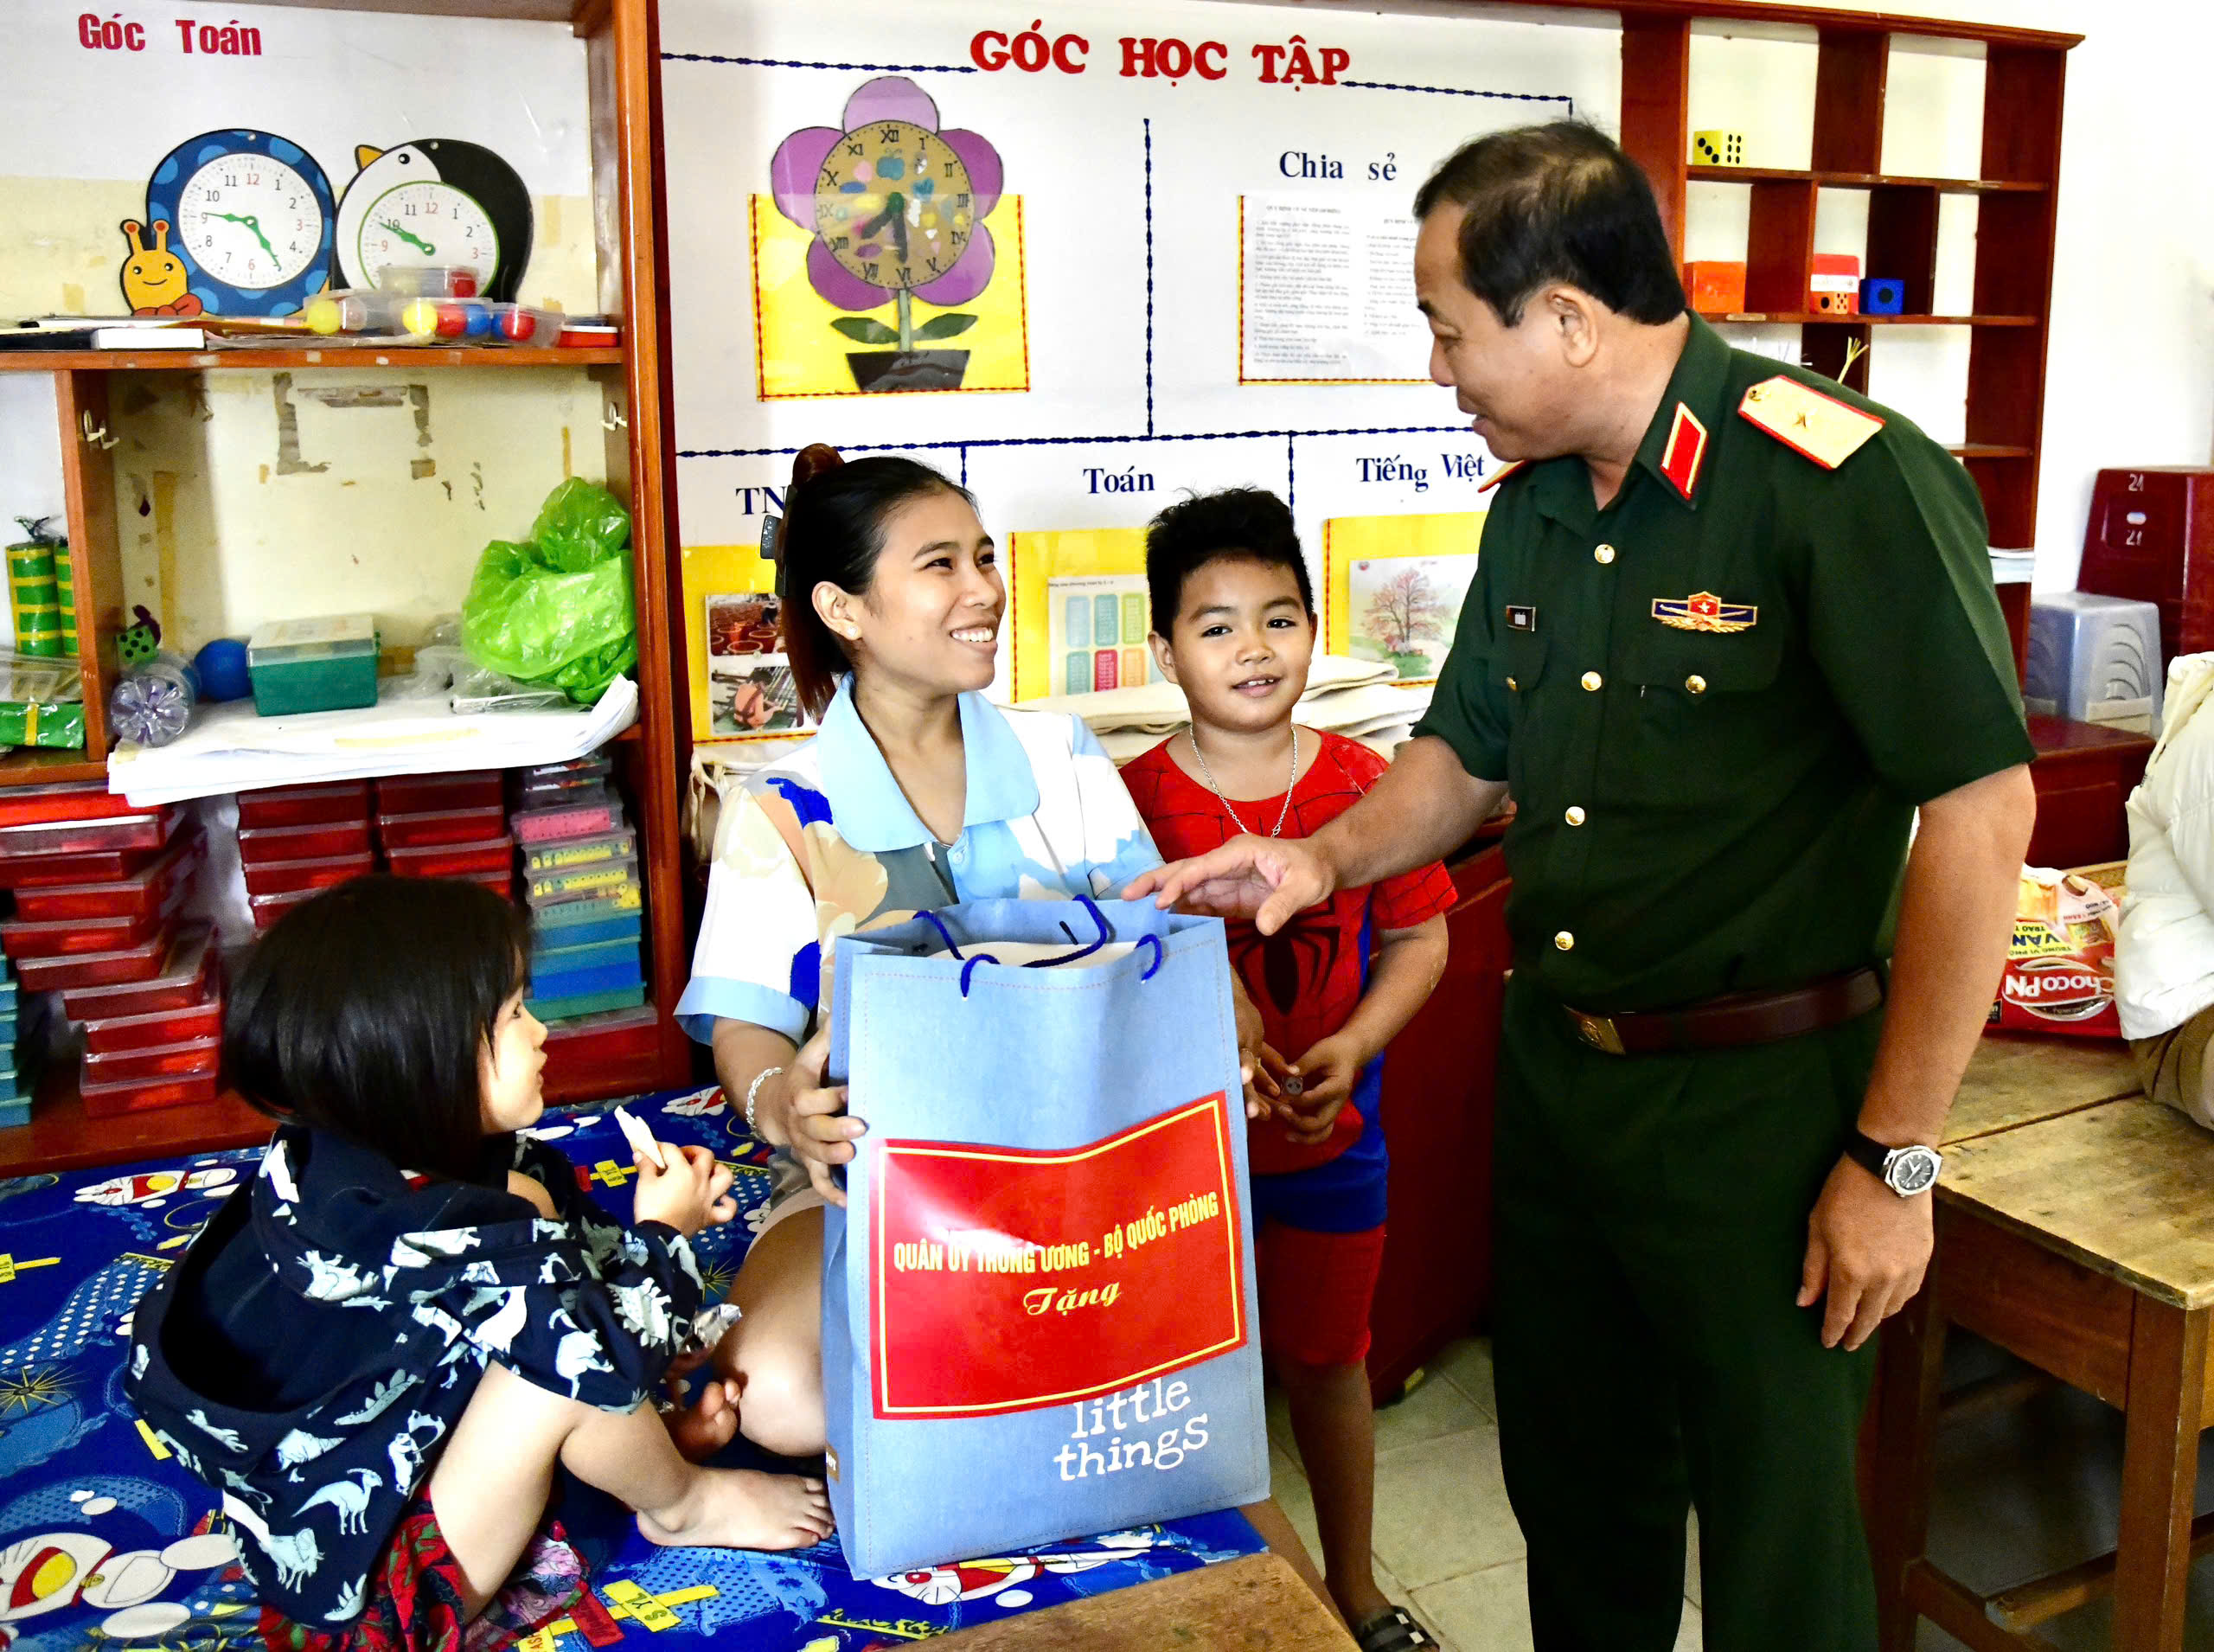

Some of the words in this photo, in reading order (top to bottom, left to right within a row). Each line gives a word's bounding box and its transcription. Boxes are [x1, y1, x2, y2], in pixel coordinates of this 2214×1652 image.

[78, 13, 146, 52] Góc
[175, 19, 262, 56] Toán
[969, 18, 1090, 74] GÓC
[1117, 37, 1228, 87] HỌC
[1251, 35, 1350, 93] TẬP
[848, 144, 863, 156] XI
[1279, 150, 1344, 179] Chia
[1367, 152, 1397, 181] sẻ
[225, 175, 237, 187] 11
[246, 173, 259, 185] 12
[275, 179, 281, 190] 1
[827, 171, 839, 187] X
[205, 190, 220, 202] 10
[289, 198, 297, 209] 2
[405, 204, 417, 215] 11
[425, 202, 438, 215] 12
[453, 208, 458, 220] 1
[297, 219, 303, 231] 3
[465, 227, 473, 237] 2
[205, 235, 212, 247] 8
[289, 241, 297, 252] 4
[381, 240, 388, 252] 9
[226, 252, 232, 263] 7
[472, 247, 478, 259] 3
[248, 259, 255, 270] 6
[1355, 453, 1429, 493] Tiếng
[1440, 452, 1486, 483] Việt
[1082, 465, 1156, 495] Toán
[2128, 473, 2144, 492] 21
[893, 1238, 944, 1273] QUÂN
[1104, 1224, 1123, 1260] BỘ
[1126, 1205, 1168, 1250] QUỐC
[1168, 1191, 1219, 1233] PHÒNG
[1023, 1281, 1123, 1316] Tặng
[1071, 1377, 1192, 1439] little
[1053, 1412, 1209, 1482] things
